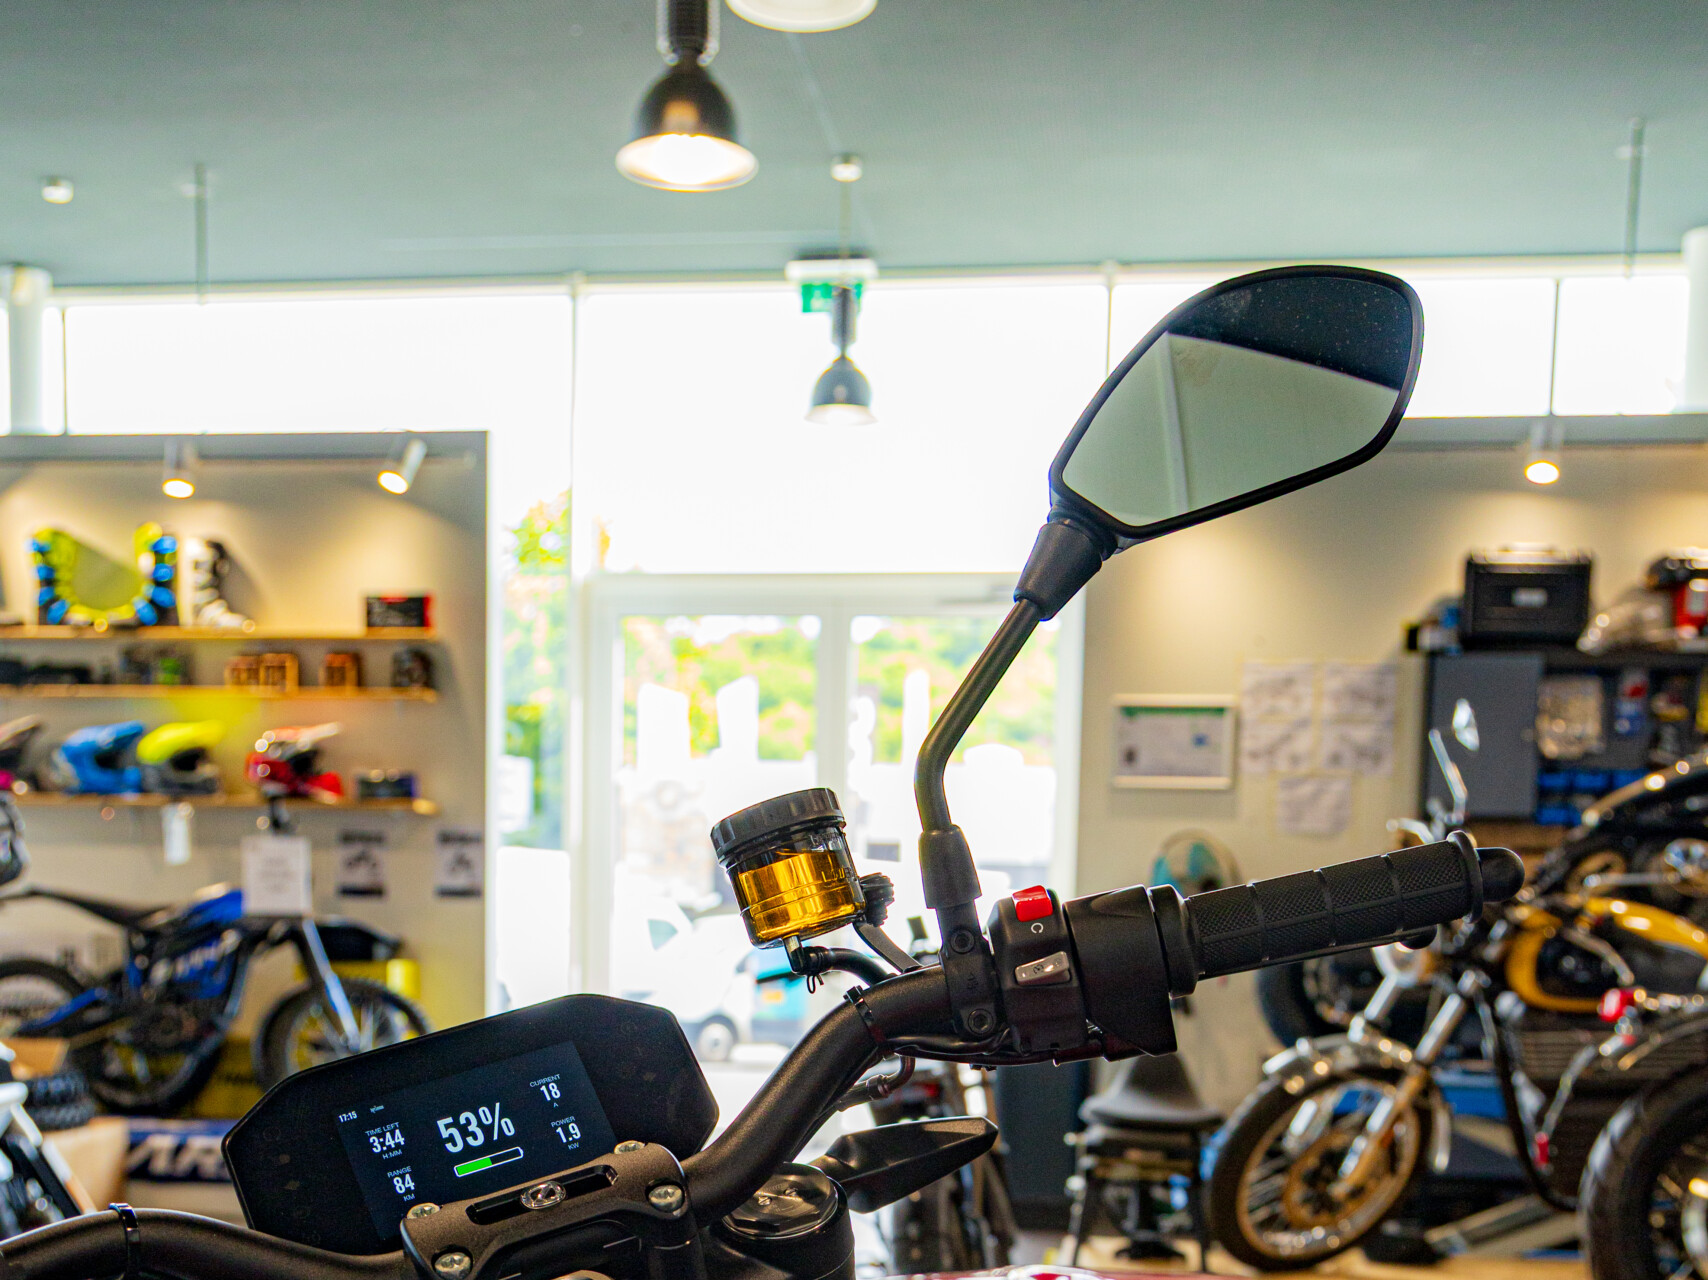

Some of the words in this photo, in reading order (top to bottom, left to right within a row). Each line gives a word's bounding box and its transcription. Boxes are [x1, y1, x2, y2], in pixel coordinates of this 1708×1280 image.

[529, 1074, 560, 1088] CURRENT
[540, 1082, 561, 1102] 18
[338, 1110, 358, 1123] 17:15
[551, 1116, 575, 1128] POWER
[365, 1127, 382, 1137] TIME
[383, 1122, 399, 1132] LEFT
[436, 1102, 516, 1153] 53%
[556, 1123, 581, 1143] 1.9
[369, 1129, 405, 1153] 3:44
[387, 1165, 412, 1178] RANGE
[393, 1173, 415, 1194] 84
[403, 1193, 415, 1202] KM
